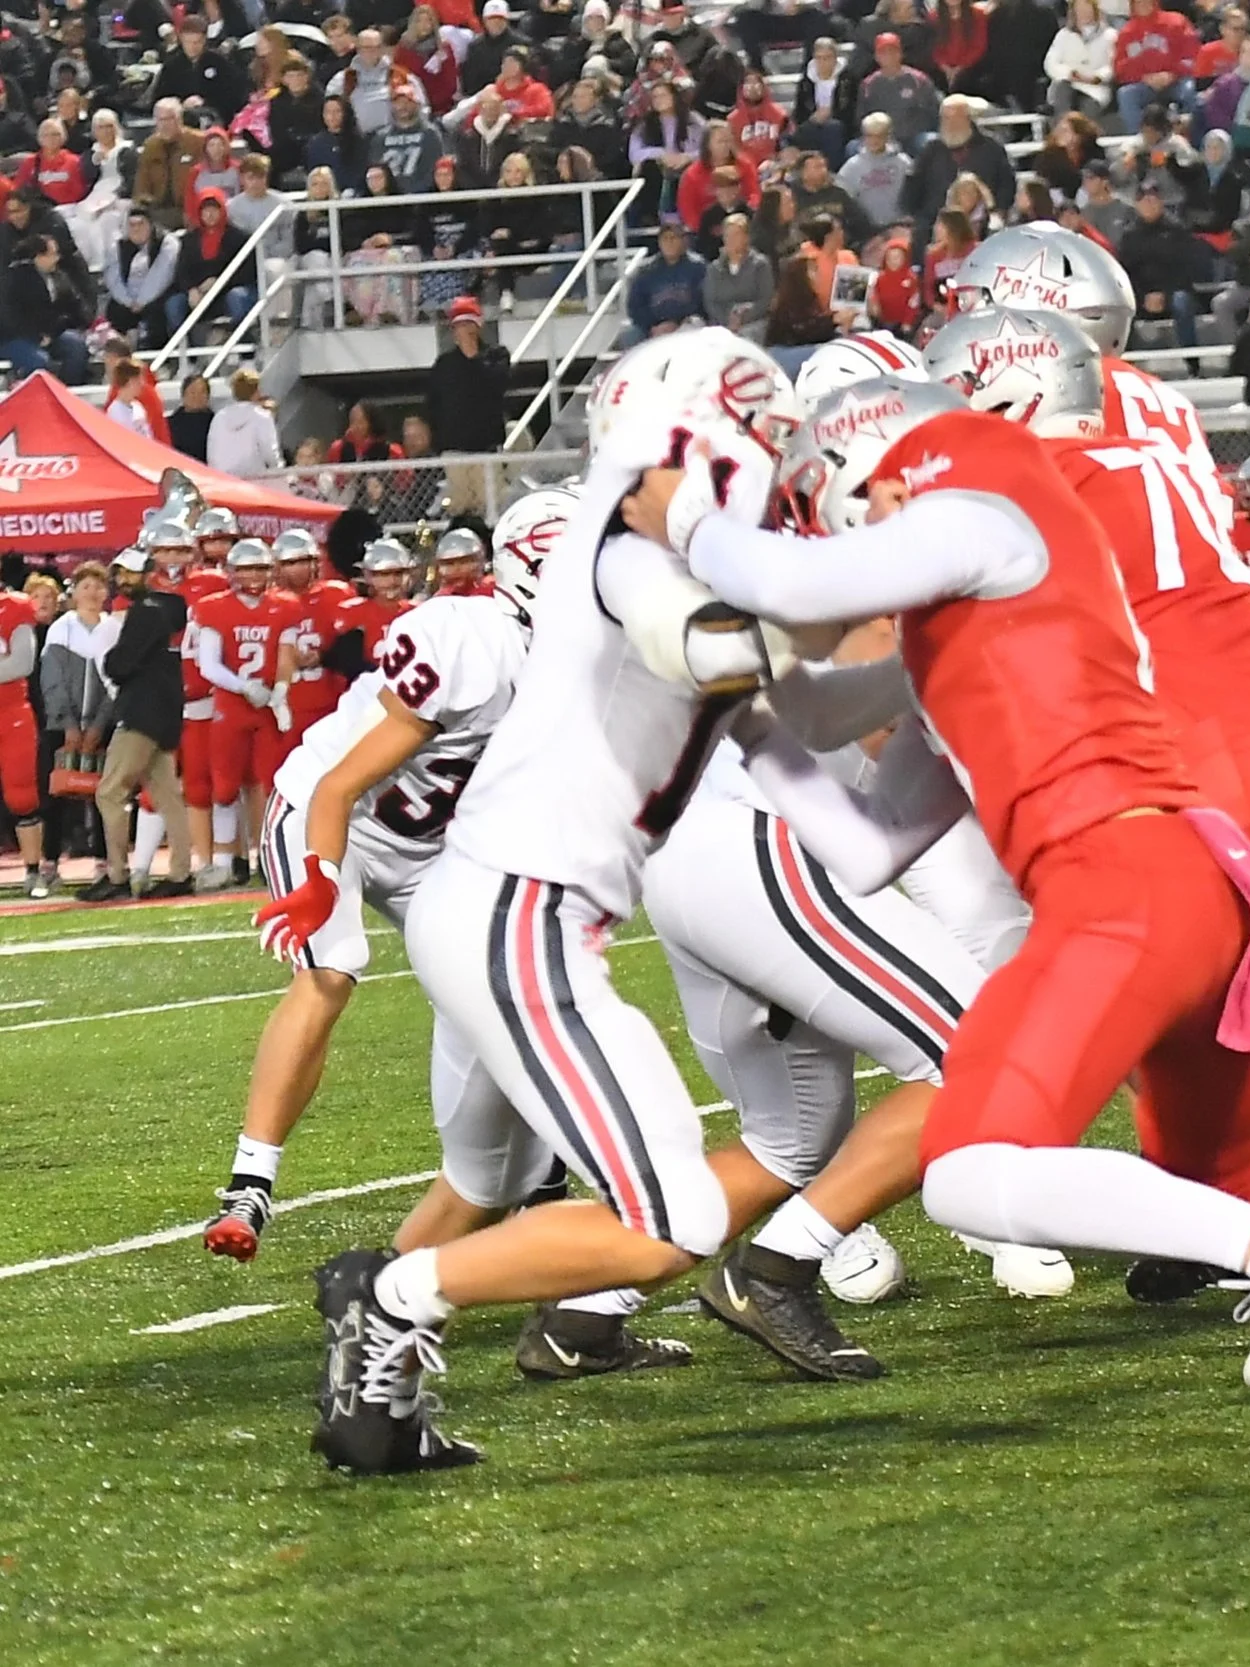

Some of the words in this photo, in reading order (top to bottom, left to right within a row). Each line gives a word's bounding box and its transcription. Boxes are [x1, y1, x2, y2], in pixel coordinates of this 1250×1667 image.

[966, 331, 1061, 373] Trojans
[811, 396, 907, 446] Trojans
[0, 510, 105, 537] EDICINE
[232, 625, 271, 642] TROY
[238, 642, 265, 683] 2
[381, 632, 441, 710] 33
